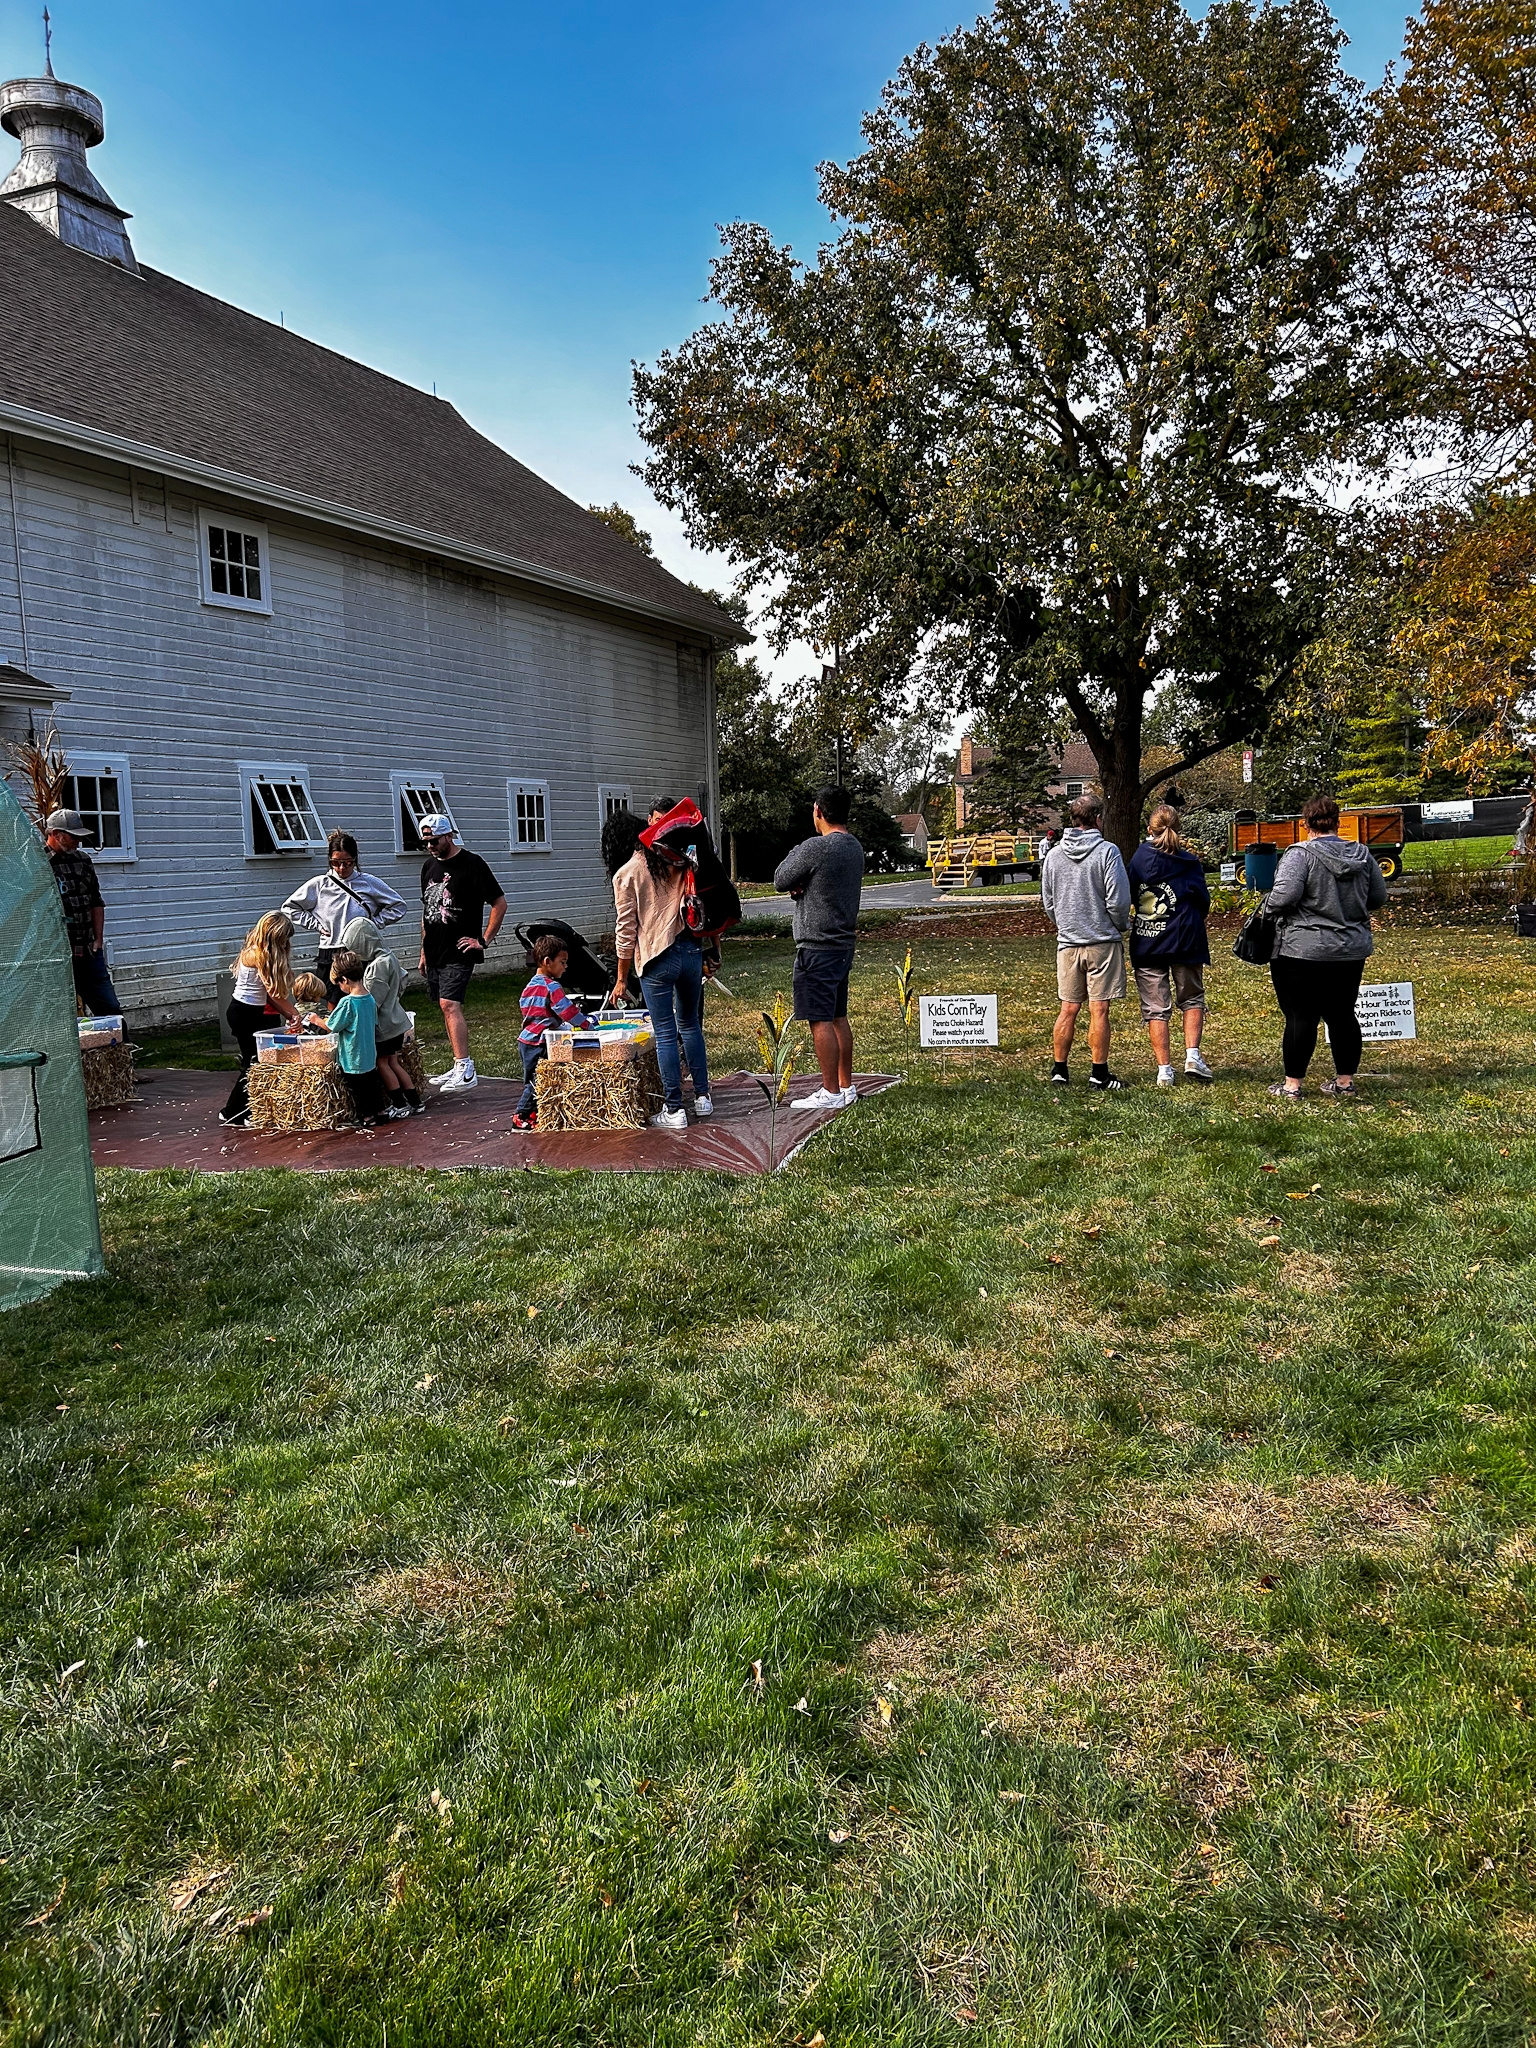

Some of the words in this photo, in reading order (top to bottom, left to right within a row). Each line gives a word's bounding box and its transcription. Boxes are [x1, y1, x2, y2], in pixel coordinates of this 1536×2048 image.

[1145, 921, 1167, 931] PAGE
[1136, 928, 1161, 938] COUNTY
[1363, 990, 1368, 998] of
[1361, 1000, 1381, 1009] Hour
[1382, 999, 1411, 1007] Tractor
[928, 1003, 946, 1016] Kids
[947, 1003, 968, 1015] Corn
[969, 1002, 988, 1018] Play
[1380, 1008, 1401, 1017] Rides
[1403, 1008, 1412, 1016] to
[932, 1019, 950, 1027] Parents
[950, 1019, 965, 1027] Choke
[1374, 1018, 1396, 1027] Farm
[932, 1028, 947, 1036] Please
[948, 1028, 962, 1036] watch
[963, 1029, 973, 1037] your
[1378, 1029, 1389, 1038] 4pm
[1390, 1029, 1403, 1038] sharp
[928, 1038, 935, 1046] No
